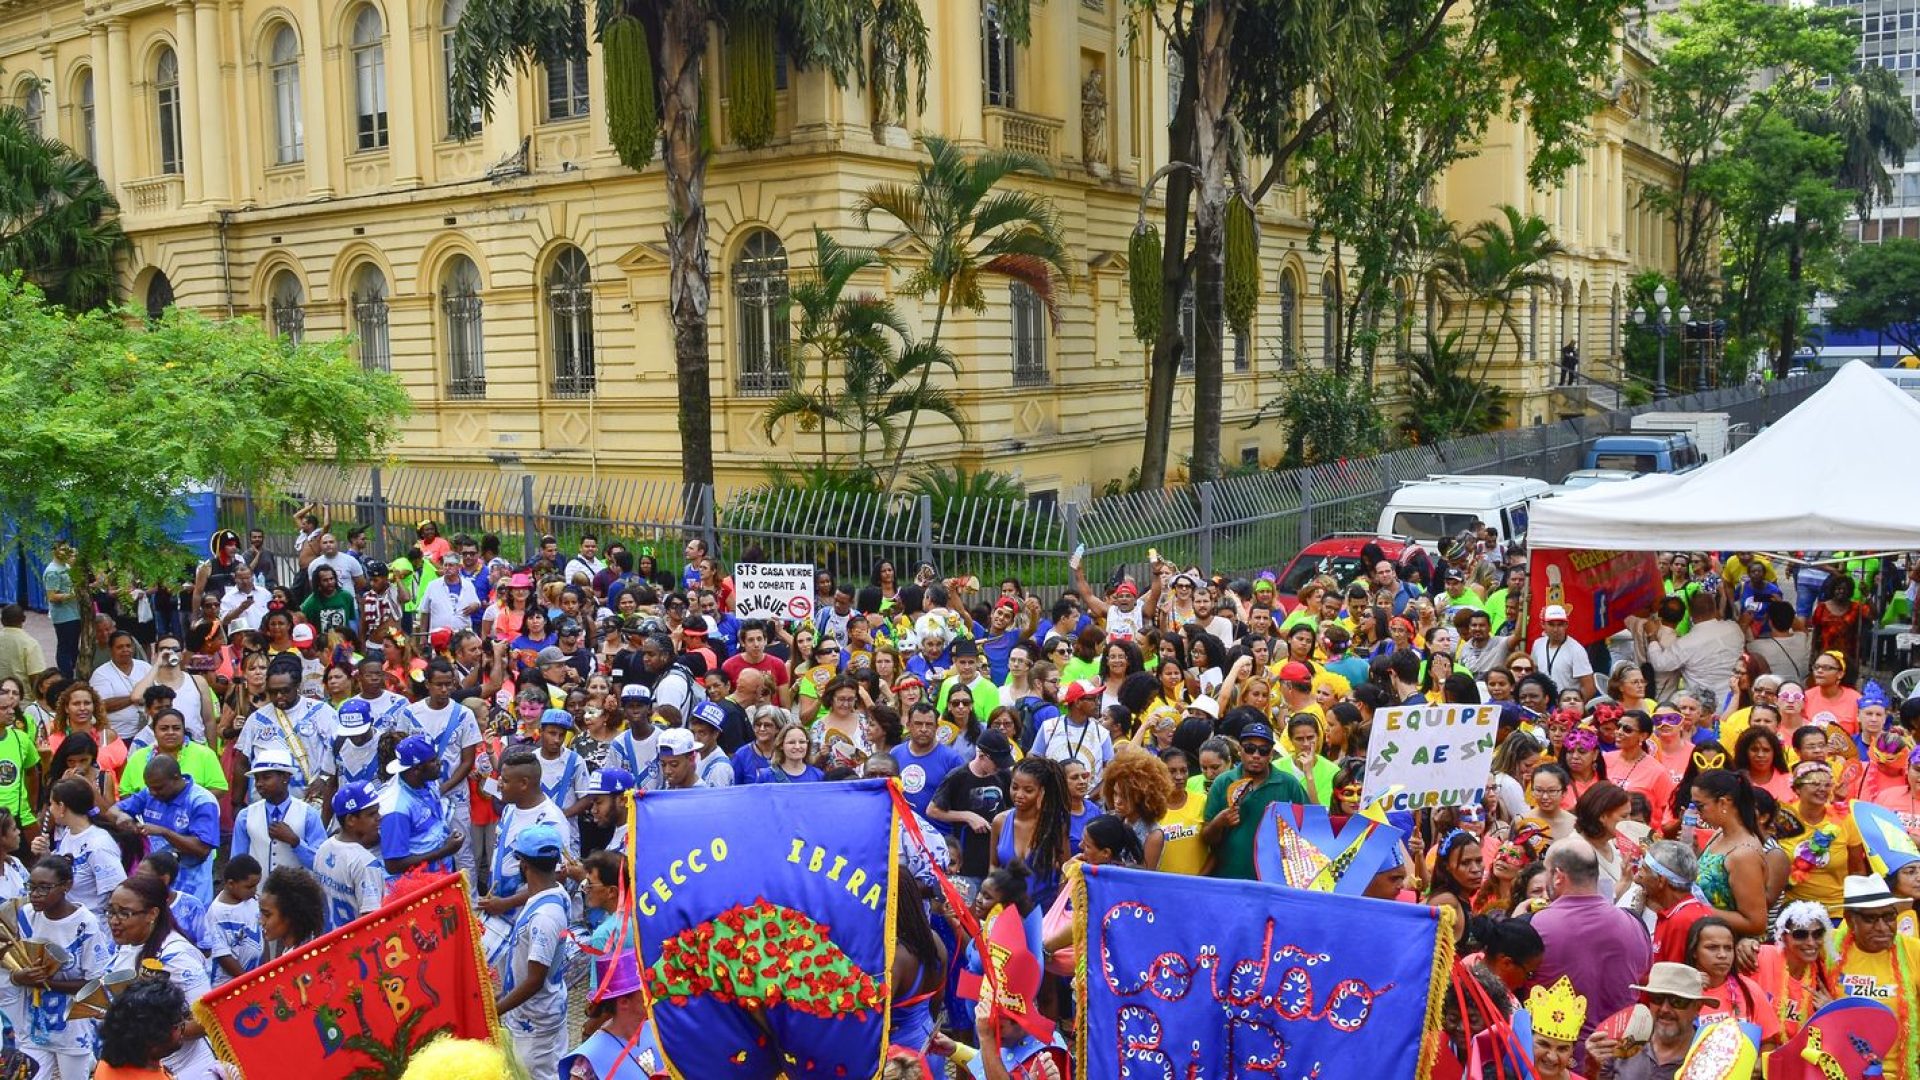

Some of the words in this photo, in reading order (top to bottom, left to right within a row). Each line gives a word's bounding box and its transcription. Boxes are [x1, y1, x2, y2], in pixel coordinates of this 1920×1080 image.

[736, 564, 758, 576] STS
[761, 567, 784, 577] CASA
[786, 567, 813, 577] VERDE
[742, 581, 756, 590] NO
[758, 581, 795, 591] COMBATE
[737, 594, 787, 616] DENGUE
[1386, 706, 1494, 732] EQUIPE
[1170, 826, 1193, 840] Zika
[638, 837, 729, 917] CECCO
[786, 838, 883, 911] IBIRA
[1101, 900, 1396, 1032] Cordão
[1853, 980, 1889, 997] Zika
